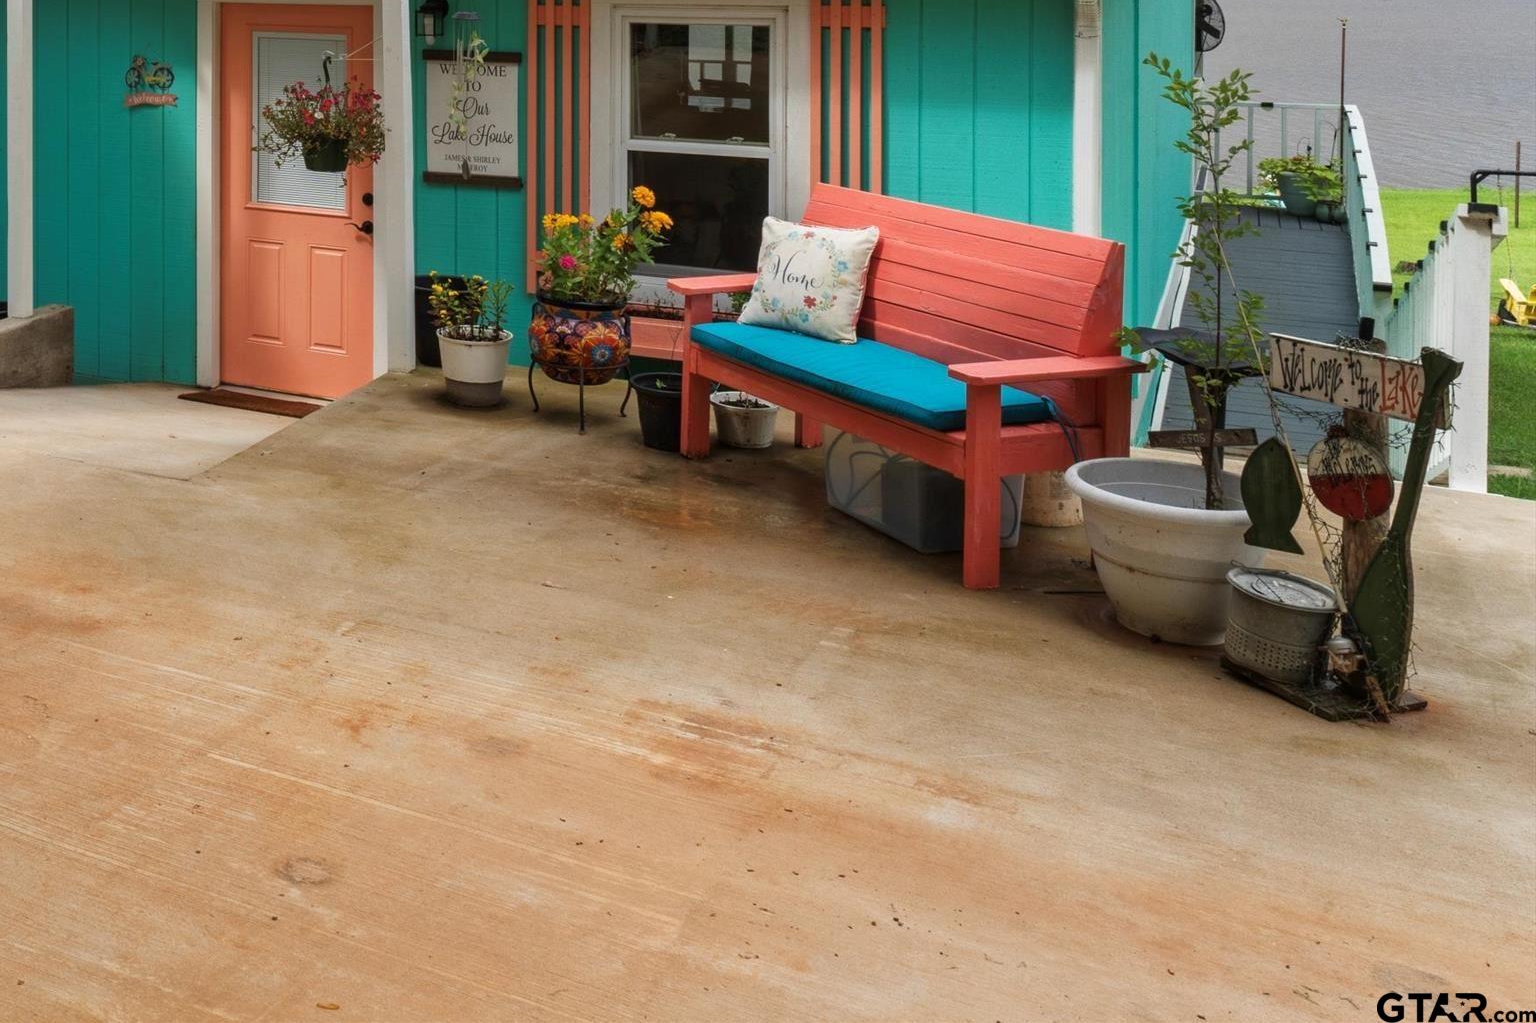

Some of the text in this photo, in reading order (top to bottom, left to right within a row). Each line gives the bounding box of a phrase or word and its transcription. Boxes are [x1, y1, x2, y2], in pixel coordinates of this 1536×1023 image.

[439, 63, 507, 77] WEOME
[464, 80, 481, 92] TO
[456, 96, 490, 119] Our
[468, 124, 514, 146] House
[473, 156, 501, 164] SHIRLEY
[767, 249, 824, 290] Home
